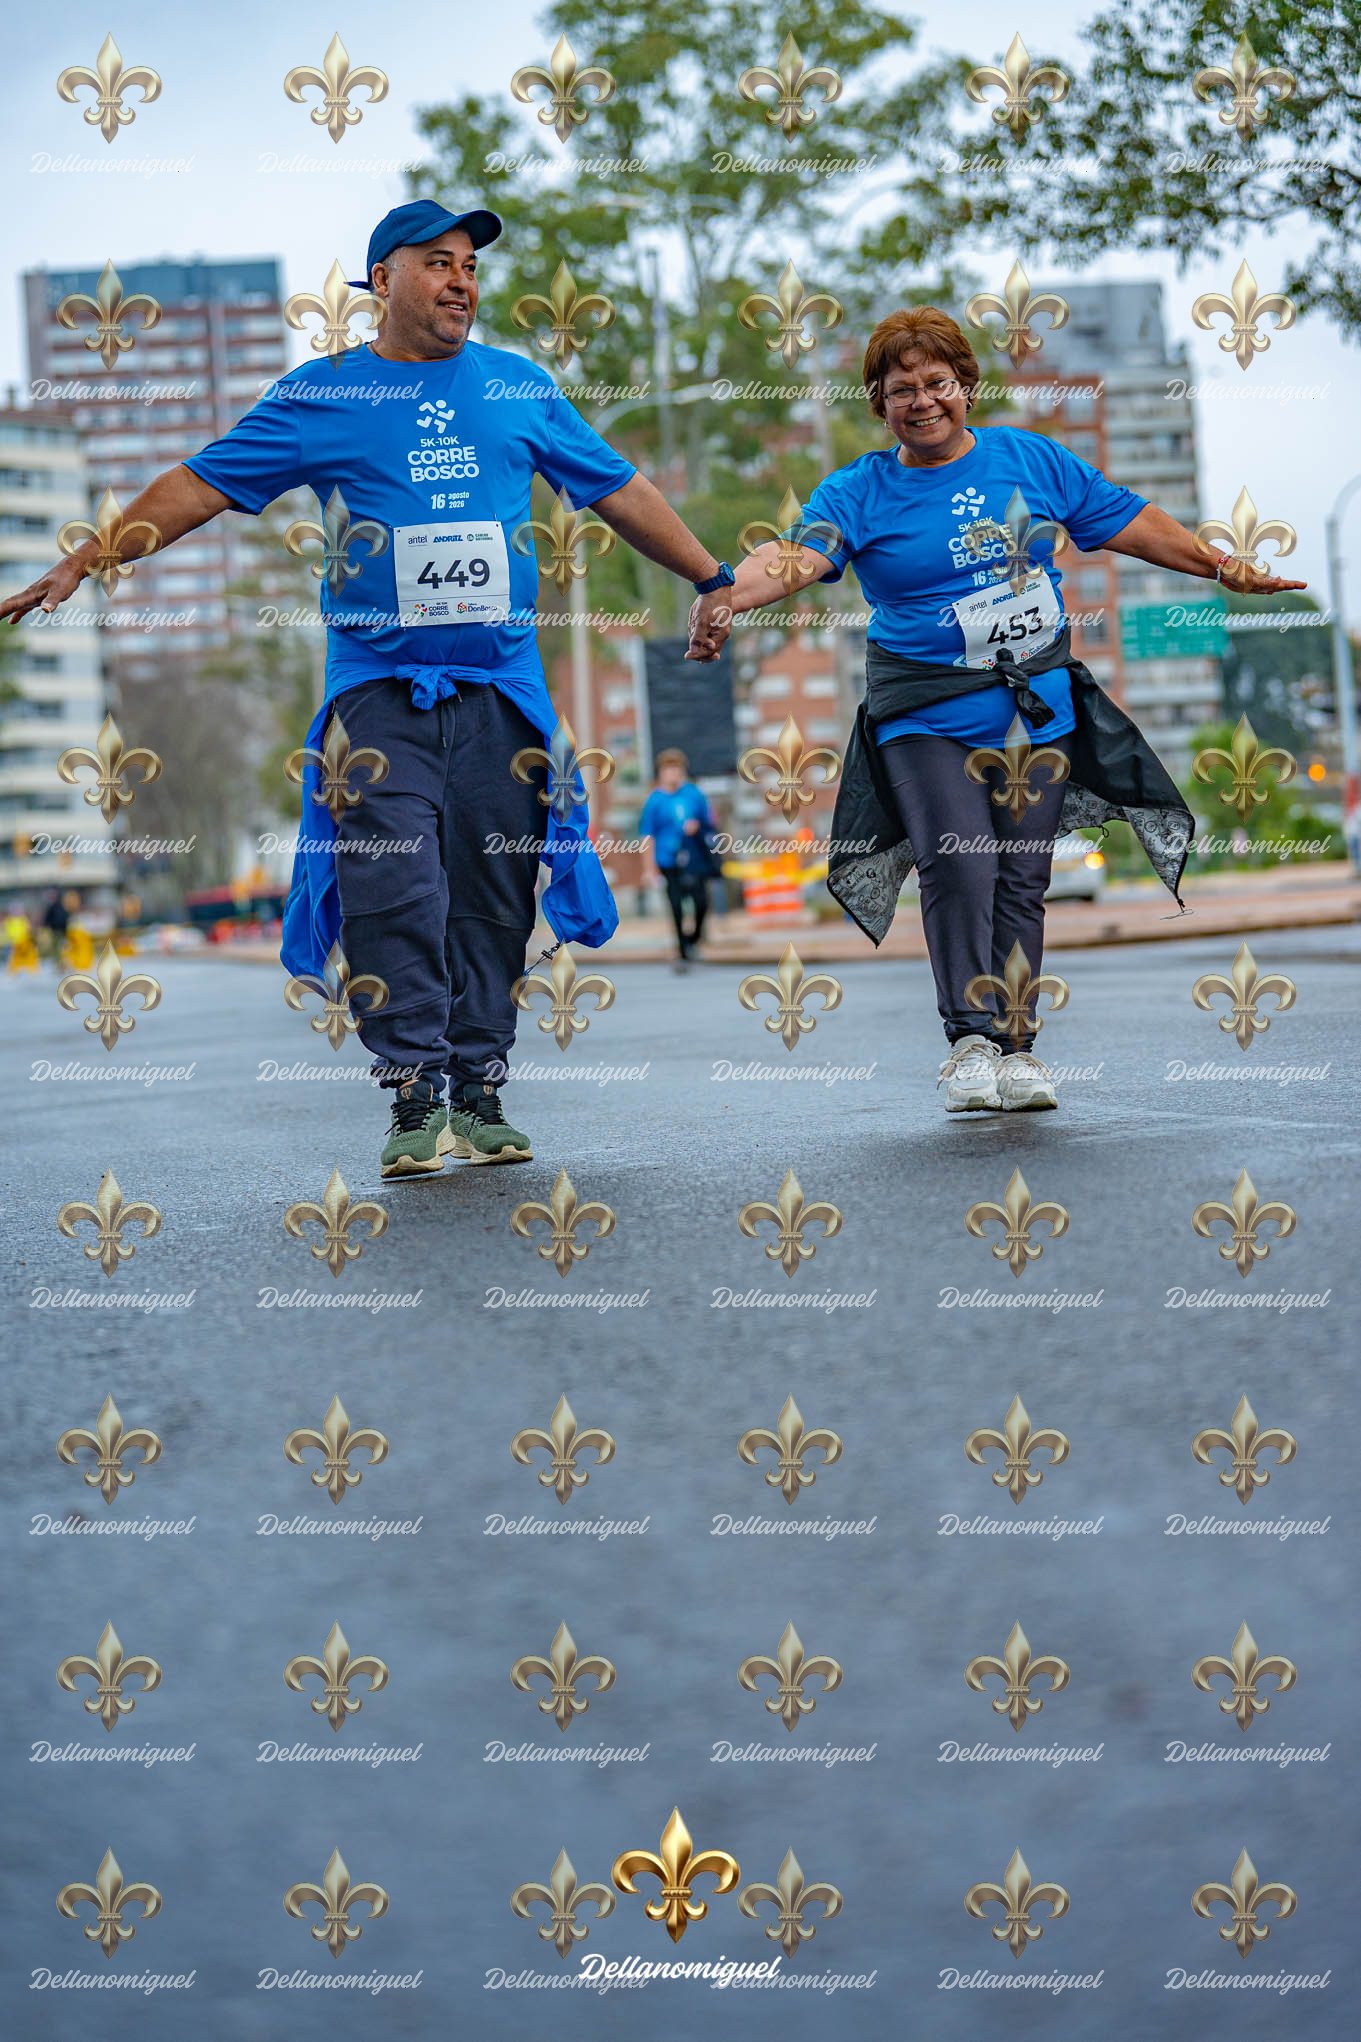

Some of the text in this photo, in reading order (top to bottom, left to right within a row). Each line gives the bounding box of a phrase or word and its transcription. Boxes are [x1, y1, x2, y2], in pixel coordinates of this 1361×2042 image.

[420, 436, 459, 448] 5K-10K
[407, 446, 477, 465] CORRE
[410, 462, 480, 482] BOSCO
[431, 491, 470, 510] 16 agosto
[958, 516, 995, 533] 5K-10K
[408, 535, 428, 545] antel
[948, 523, 1014, 552] CORRE
[952, 540, 1017, 569] BOSCO
[417, 558, 490, 589] 449
[972, 569, 987, 587] 16
[968, 600, 988, 612] antel
[987, 606, 1044, 645] 453
